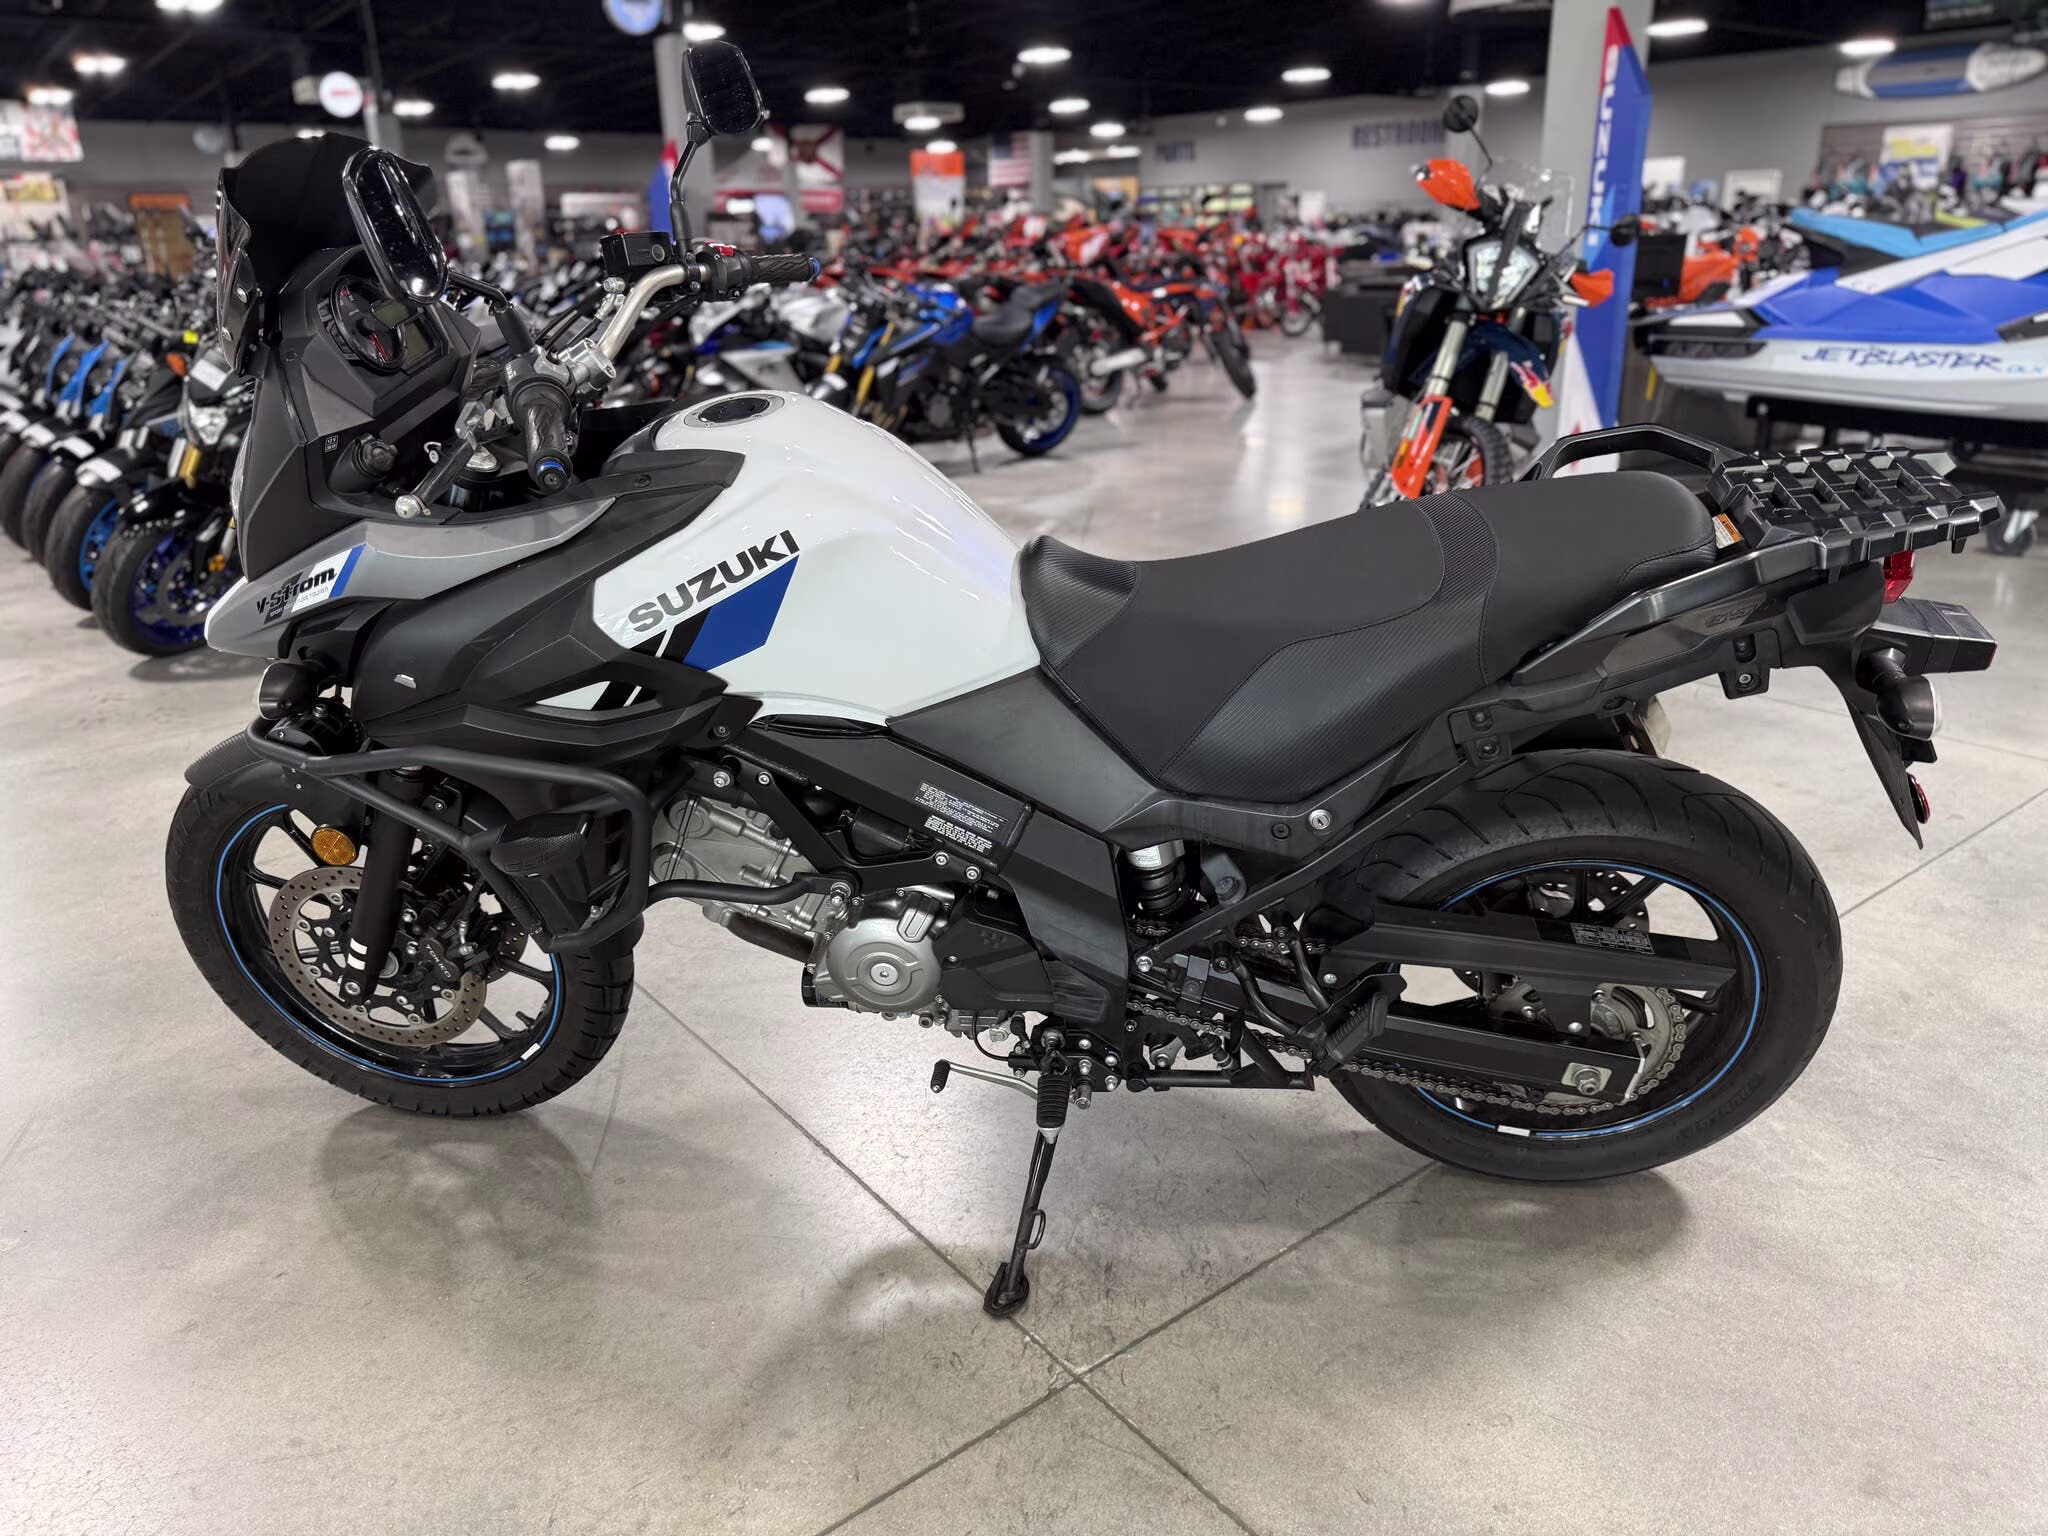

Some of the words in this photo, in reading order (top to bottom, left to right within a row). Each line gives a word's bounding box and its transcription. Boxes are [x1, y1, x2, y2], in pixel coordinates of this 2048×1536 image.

[256, 567, 338, 614] V-Strom
[628, 529, 800, 633] SUZUKI
[426, 943, 452, 978] TOKICO
